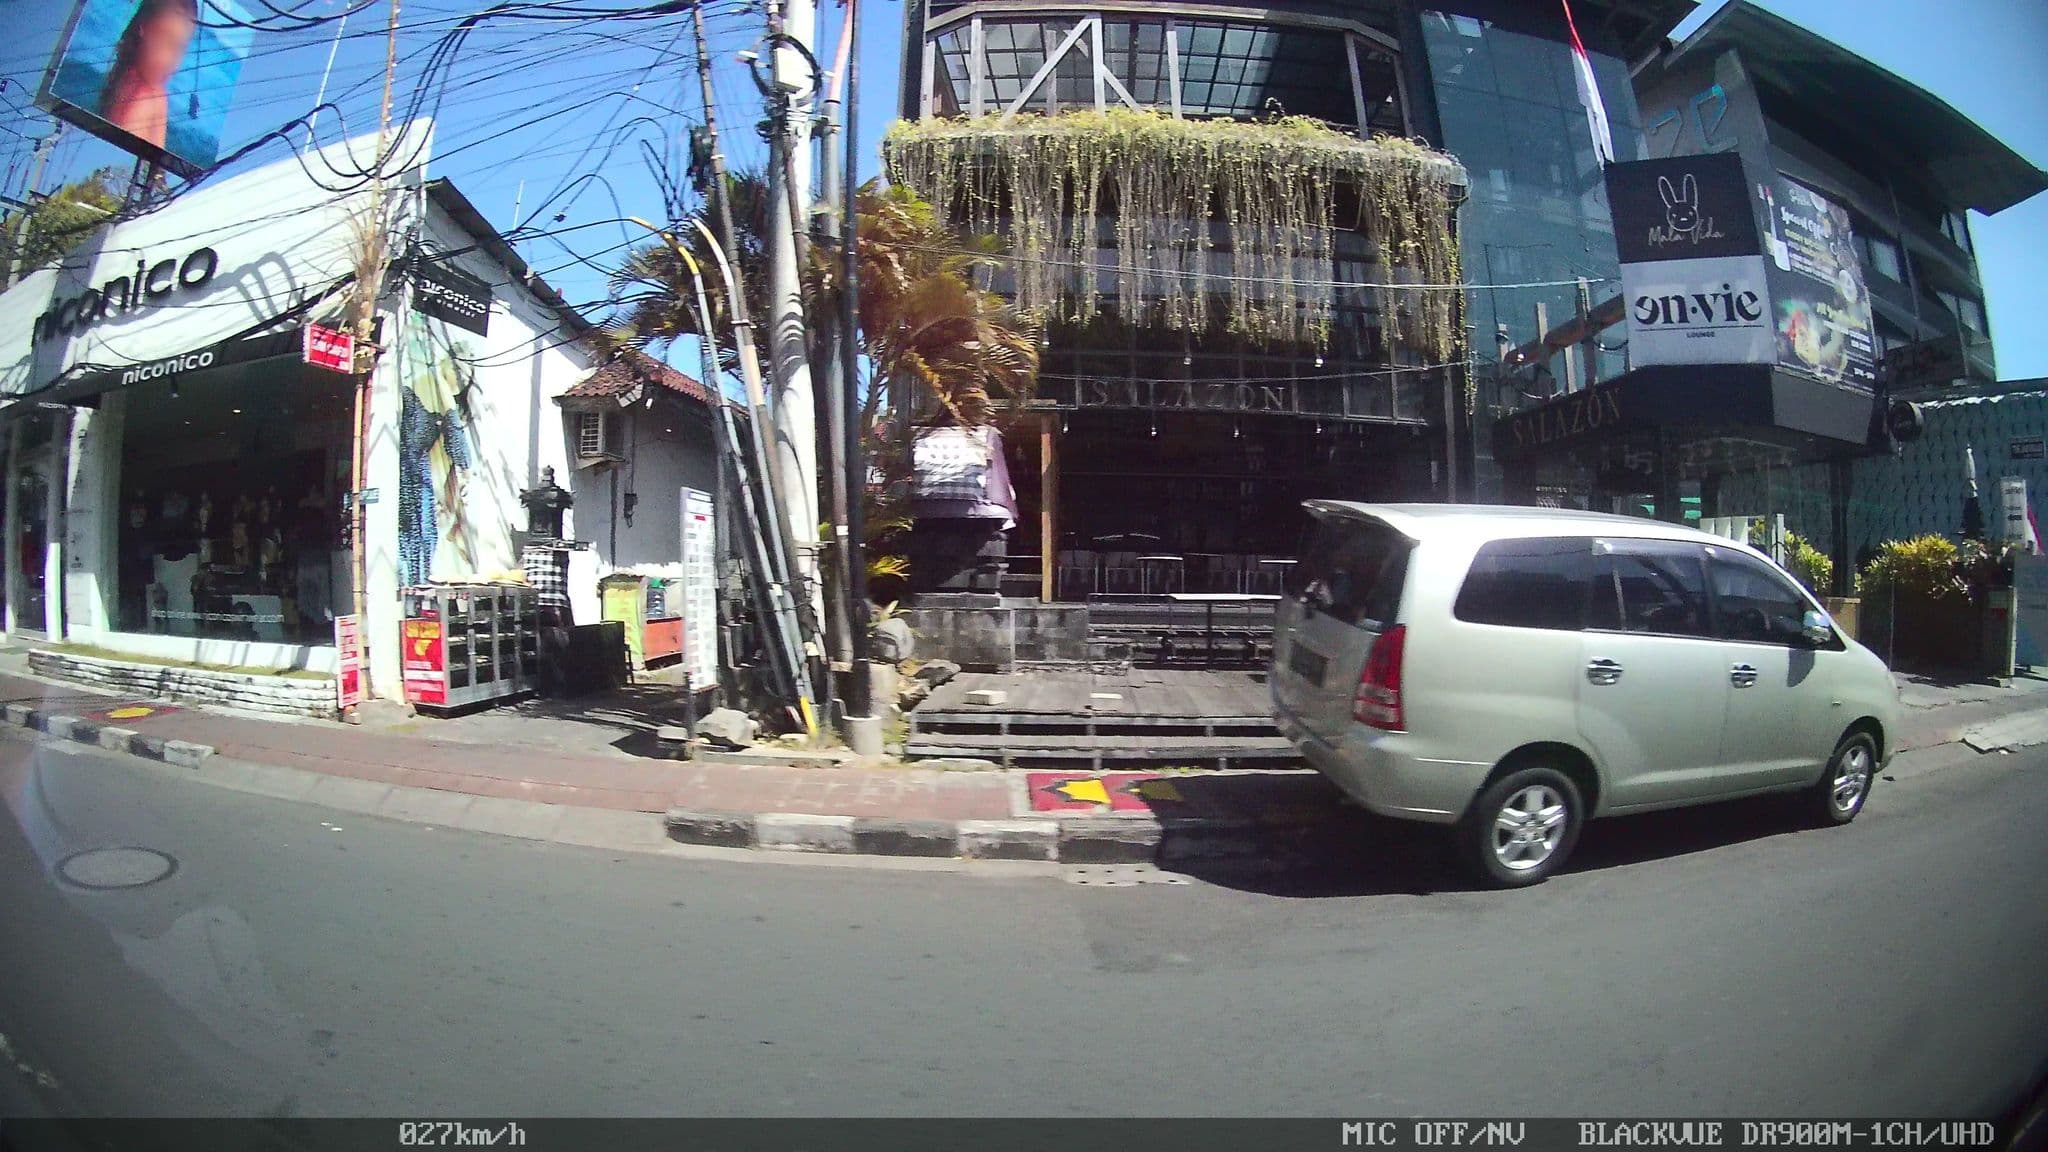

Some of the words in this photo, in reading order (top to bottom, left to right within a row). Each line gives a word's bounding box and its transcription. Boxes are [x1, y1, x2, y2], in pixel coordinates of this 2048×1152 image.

[30, 247, 219, 348] niconico
[1686, 331, 1716, 339] LOUNGE
[121, 351, 214, 385] niconico
